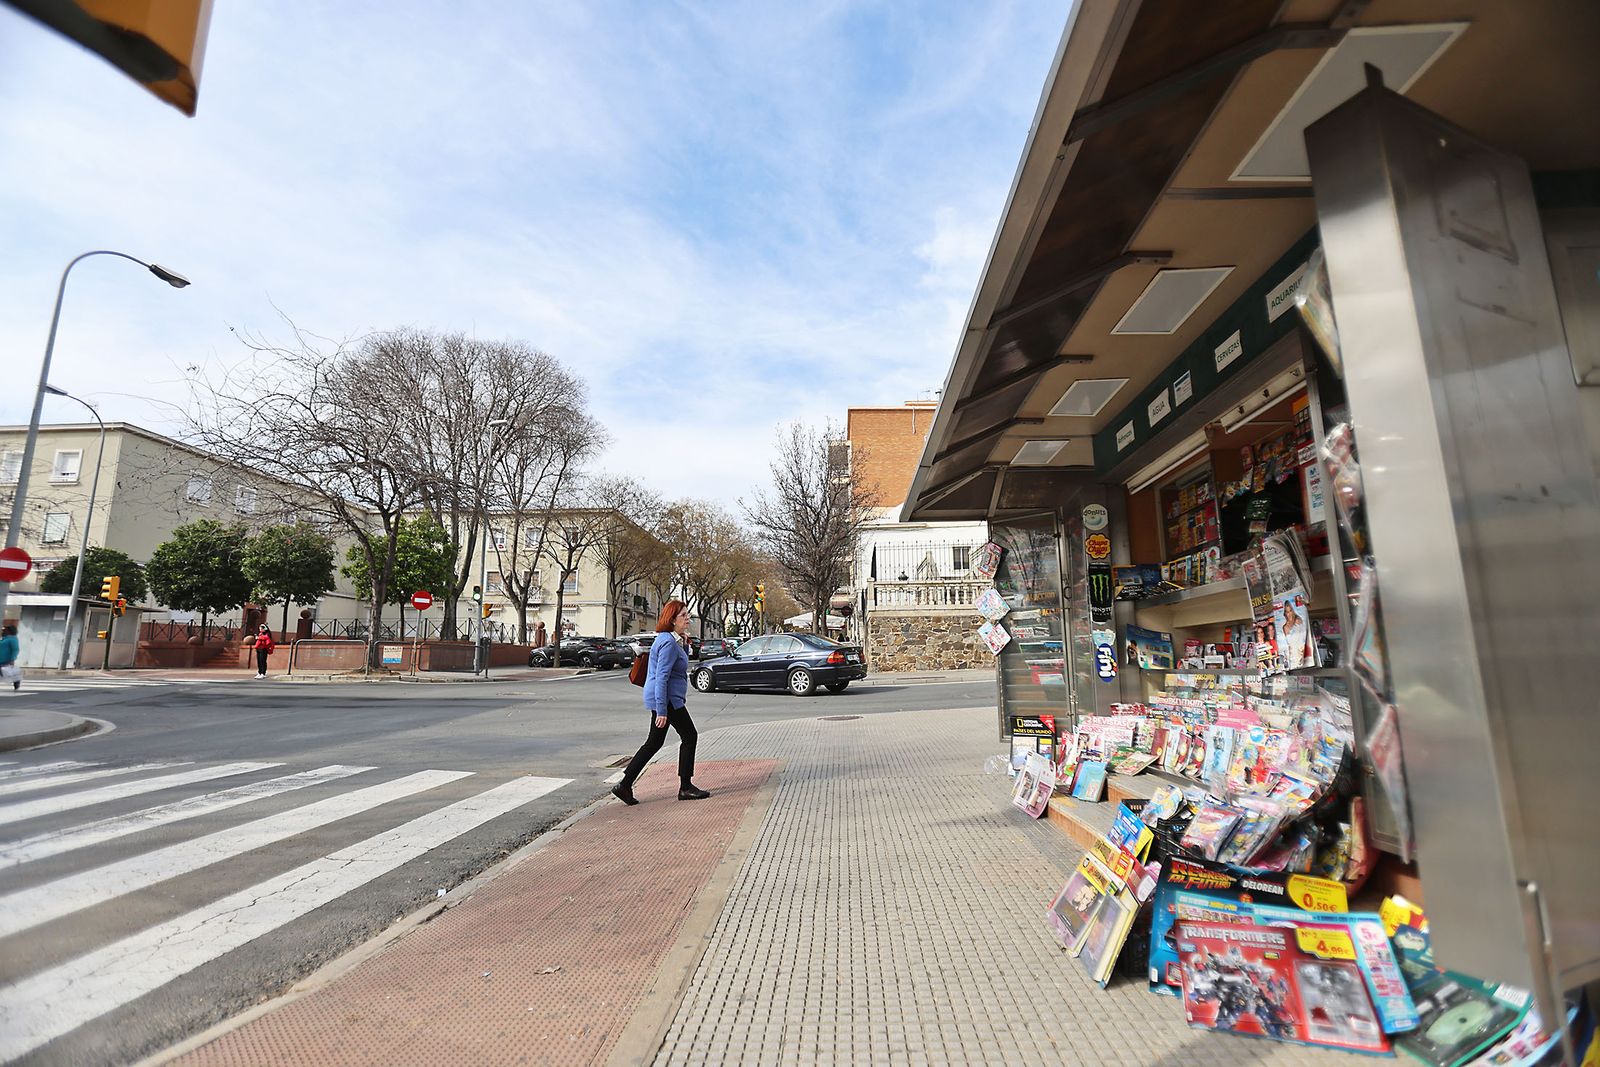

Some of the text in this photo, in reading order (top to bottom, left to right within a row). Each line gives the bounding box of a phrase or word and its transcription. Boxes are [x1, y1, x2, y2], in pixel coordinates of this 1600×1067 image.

[1216, 339, 1240, 363] CERVEZAS
[1152, 401, 1165, 416] AGUA
[1242, 880, 1284, 895] DELOREAN
[1179, 925, 1285, 945] TRANSFORMERS
